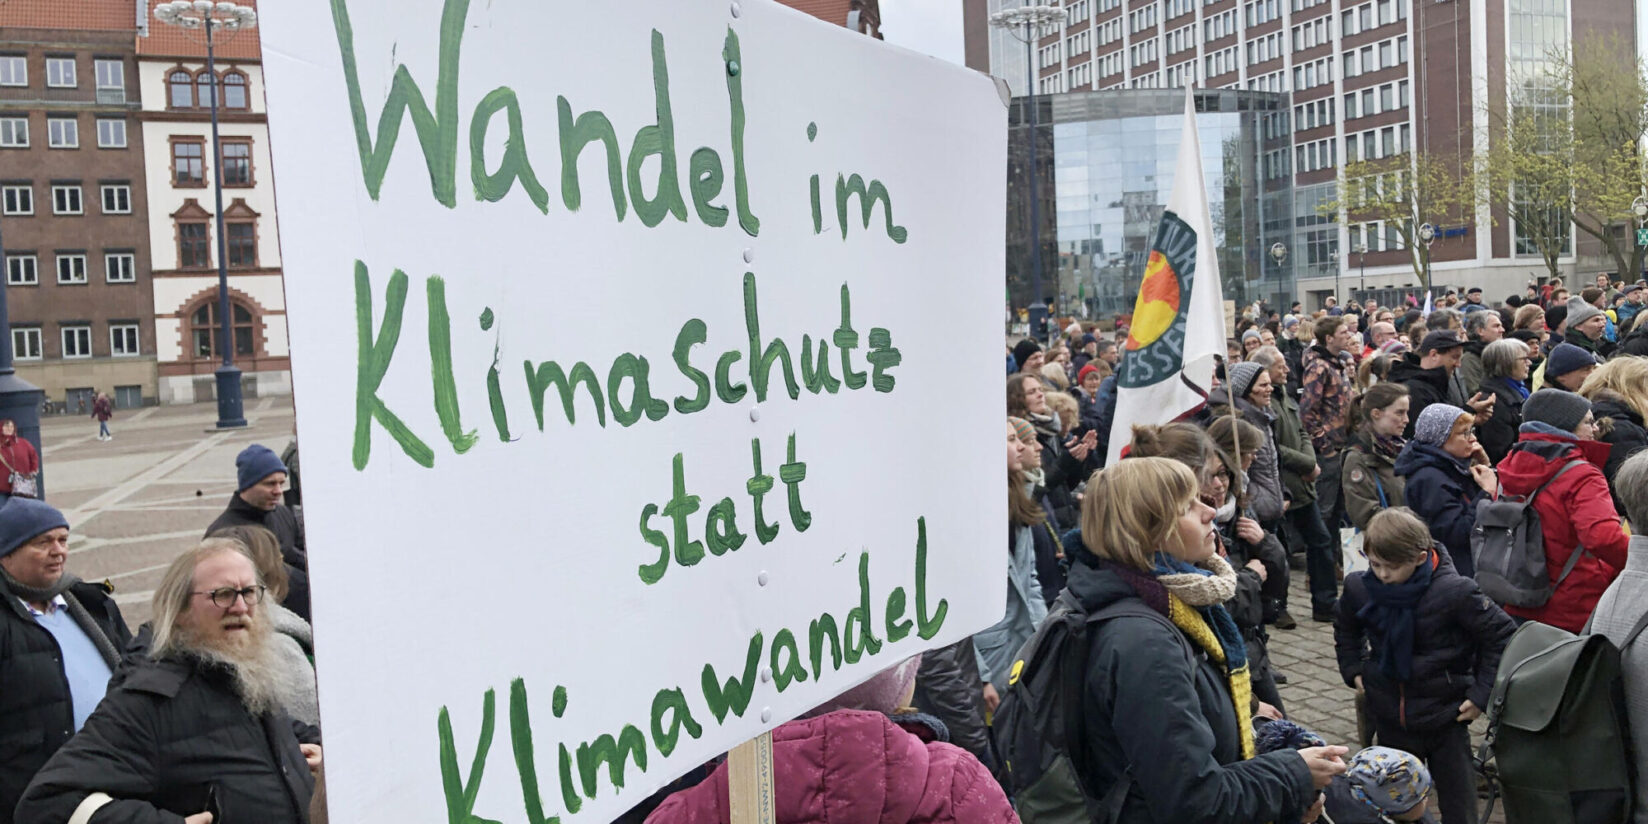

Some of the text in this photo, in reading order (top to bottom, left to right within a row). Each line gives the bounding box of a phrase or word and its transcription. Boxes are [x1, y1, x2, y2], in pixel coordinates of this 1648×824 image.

[330, 0, 908, 244] Wandel im
[352, 259, 902, 472] Klimaschutz
[638, 430, 812, 586] statt
[437, 517, 949, 824] Klimawandel
